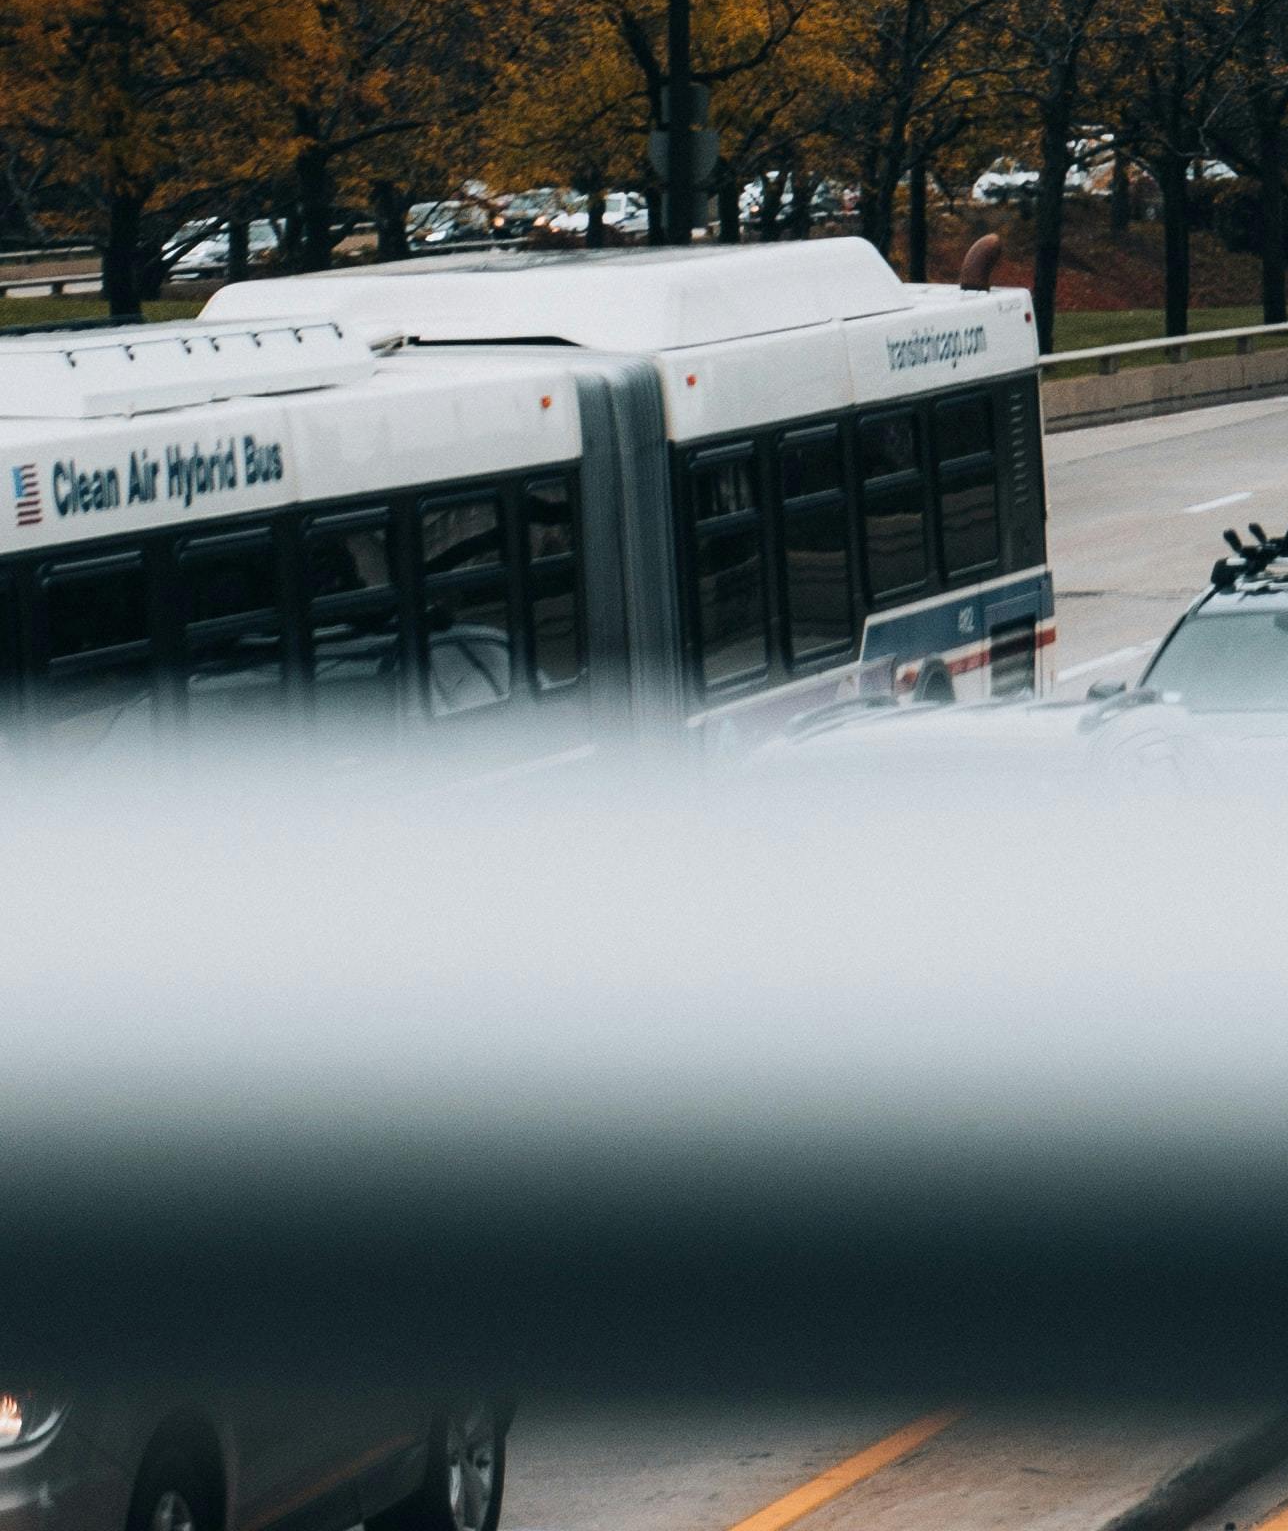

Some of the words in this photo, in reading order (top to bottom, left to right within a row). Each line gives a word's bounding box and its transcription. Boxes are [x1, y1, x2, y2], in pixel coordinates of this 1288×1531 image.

[886, 325, 987, 370] transitchicago.com
[53, 458, 120, 516] Clean
[128, 448, 160, 505] Air
[165, 437, 237, 507] Hybrid
[243, 434, 283, 486] Bus
